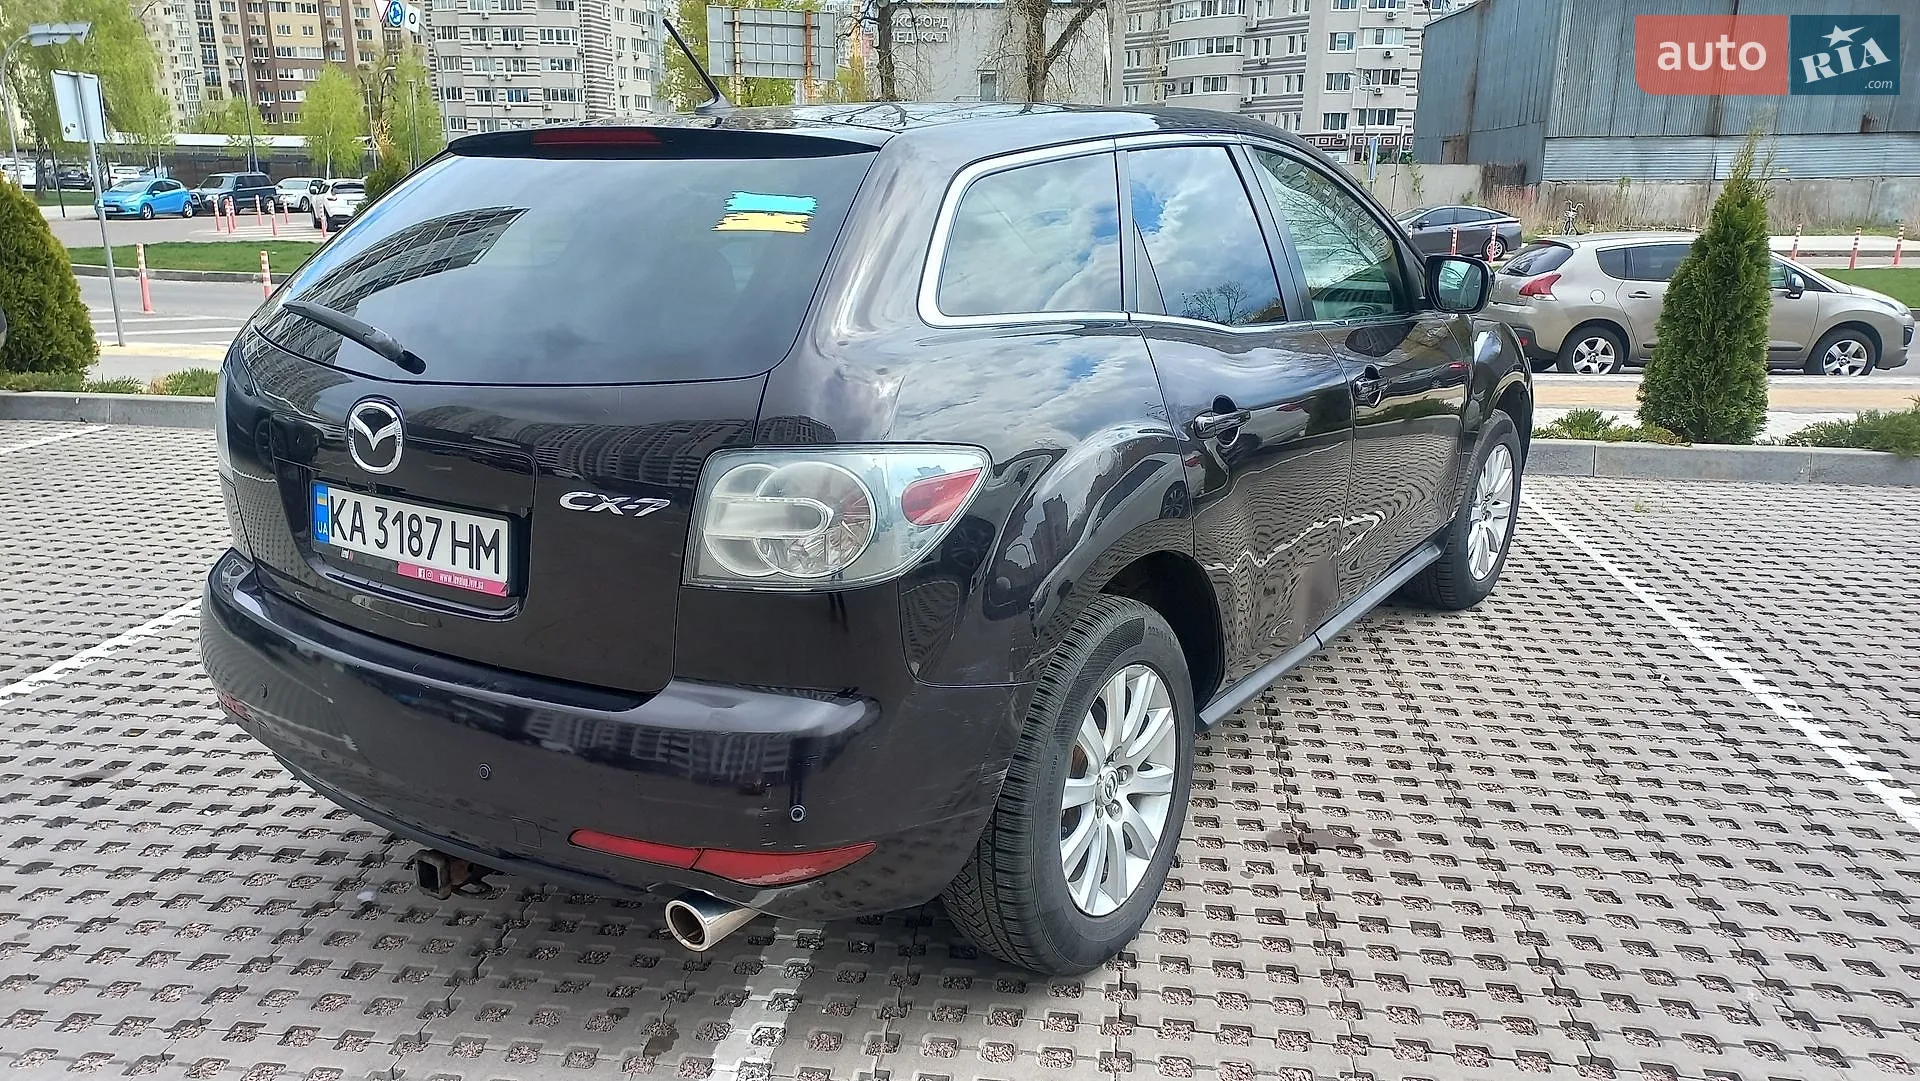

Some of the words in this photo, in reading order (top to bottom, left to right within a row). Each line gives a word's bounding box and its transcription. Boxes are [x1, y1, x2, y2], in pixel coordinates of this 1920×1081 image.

[559, 491, 671, 517] CX-7
[317, 521, 328, 535] UA
[330, 495, 367, 546] KA
[374, 505, 443, 561] 3187
[451, 520, 500, 575] HM
